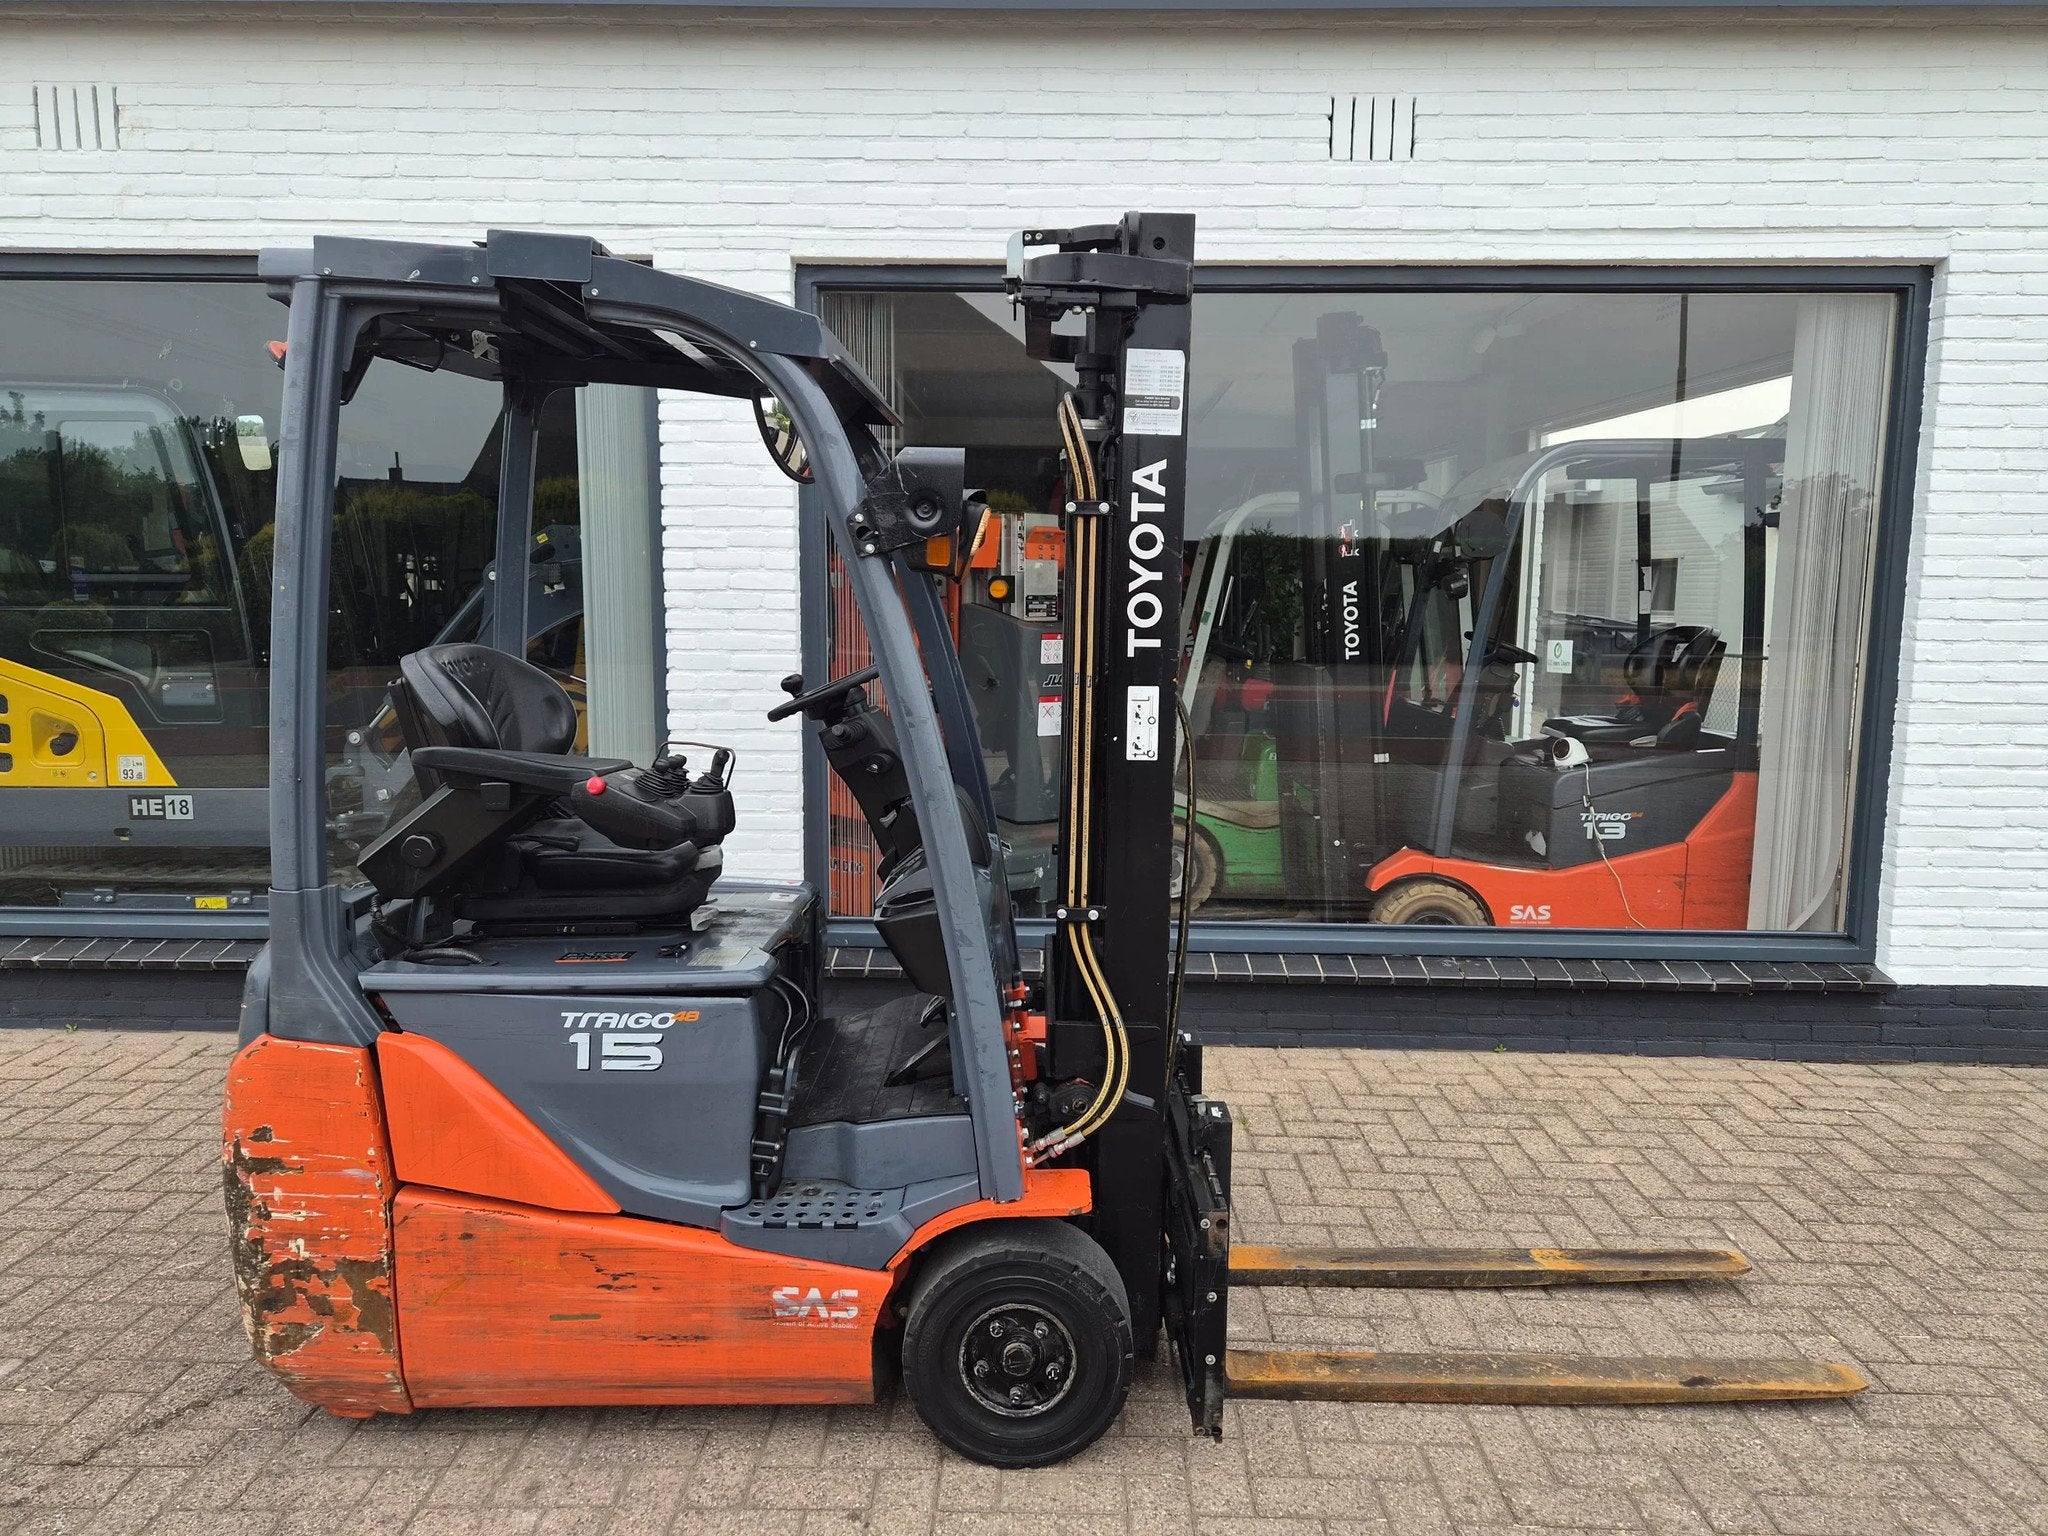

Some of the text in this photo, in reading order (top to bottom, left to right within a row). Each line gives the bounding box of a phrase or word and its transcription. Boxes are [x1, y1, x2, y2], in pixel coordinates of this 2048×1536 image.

[1126, 458, 1168, 658] TOYOTA
[1342, 580, 1361, 661] TOYOTA
[122, 768, 135, 780] 93
[1583, 822, 1626, 840] 13
[1510, 904, 1551, 920] SAS
[568, 1032, 664, 1072] 15
[772, 1286, 859, 1319] SAS
